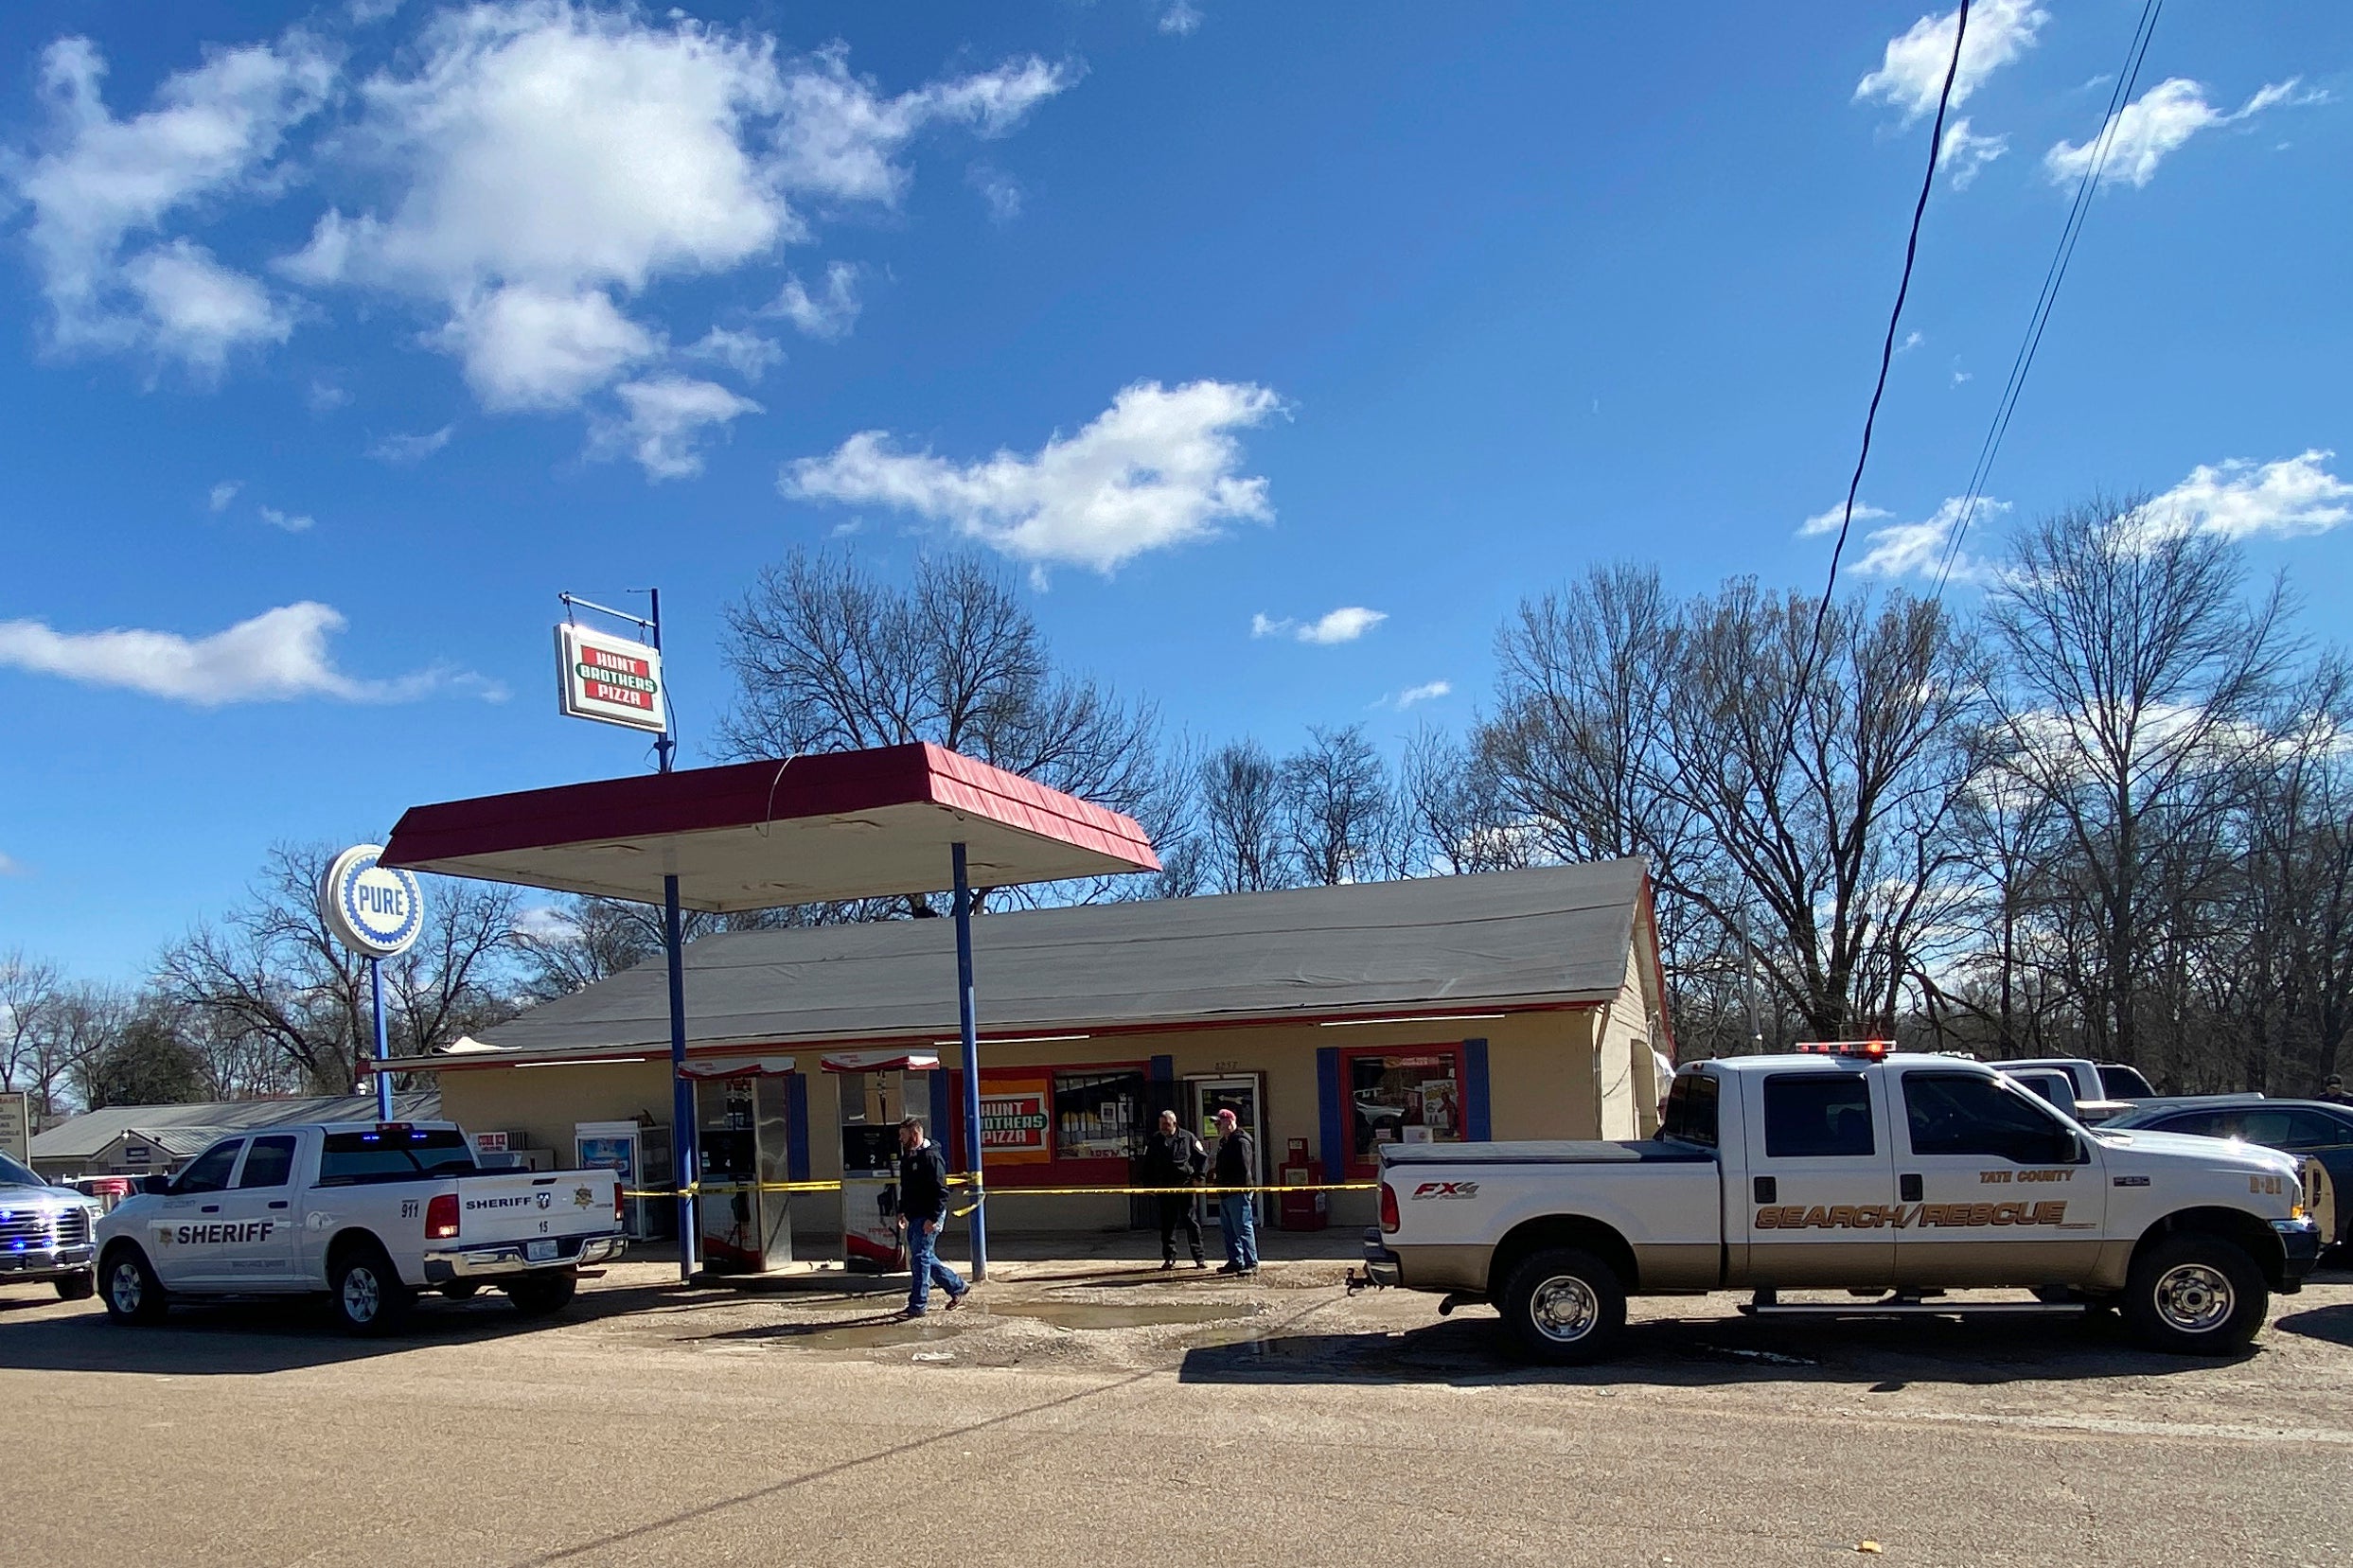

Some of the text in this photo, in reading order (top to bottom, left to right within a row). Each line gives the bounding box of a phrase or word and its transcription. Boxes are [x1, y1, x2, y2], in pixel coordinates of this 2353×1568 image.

[595, 651, 636, 673] HUNT
[579, 664, 654, 693] BROTHERS
[597, 683, 641, 705] PIZZA
[358, 884, 404, 916] PURE
[981, 1101, 1024, 1117] HUNT
[982, 1130, 1026, 1144] PIZZA
[870, 1154, 876, 1164] 2
[1980, 1170, 2075, 1183] TATE COUNTY
[1414, 1181, 1480, 1195] FX4
[401, 1203, 419, 1218] 911
[466, 1196, 532, 1210] SHERIFF
[178, 1223, 274, 1244] SHERIFF
[539, 1221, 548, 1233] 15
